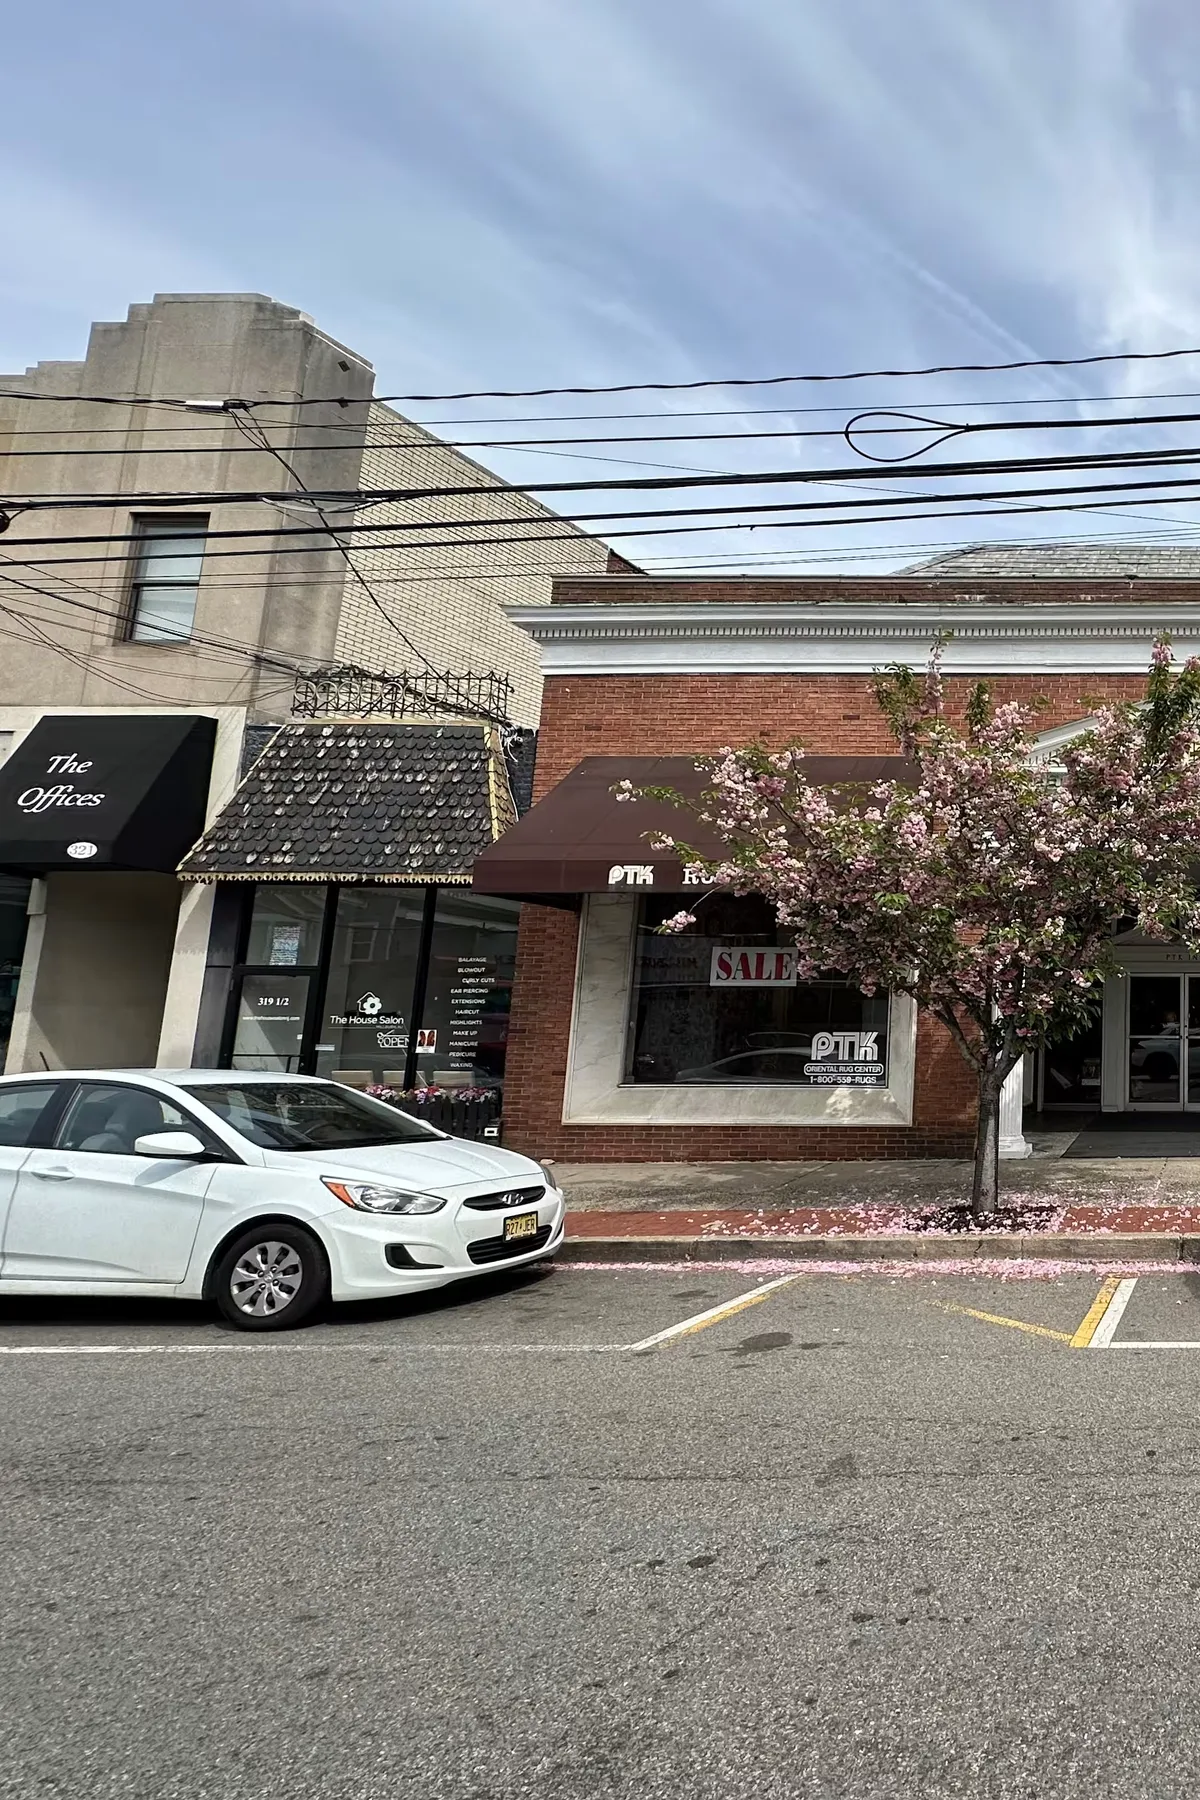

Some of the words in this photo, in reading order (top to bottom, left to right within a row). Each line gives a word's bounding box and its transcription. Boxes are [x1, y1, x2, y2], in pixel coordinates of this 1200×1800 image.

[46, 753, 94, 774] The
[17, 784, 106, 813] Offices
[69, 844, 94, 856] 321
[608, 865, 655, 885] PTK
[715, 952, 793, 981] SALE
[257, 997, 274, 1006] 319
[275, 997, 290, 1006] 1/2
[330, 1015, 348, 1025] The
[348, 1015, 378, 1025] House
[379, 1015, 404, 1025] Salon
[811, 1031, 879, 1061] PTK
[805, 1065, 838, 1073] ORIENTAL
[838, 1065, 854, 1073] RUG
[854, 1065, 881, 1073] CENTER
[809, 1075, 877, 1084] 1-800-559-RUGS
